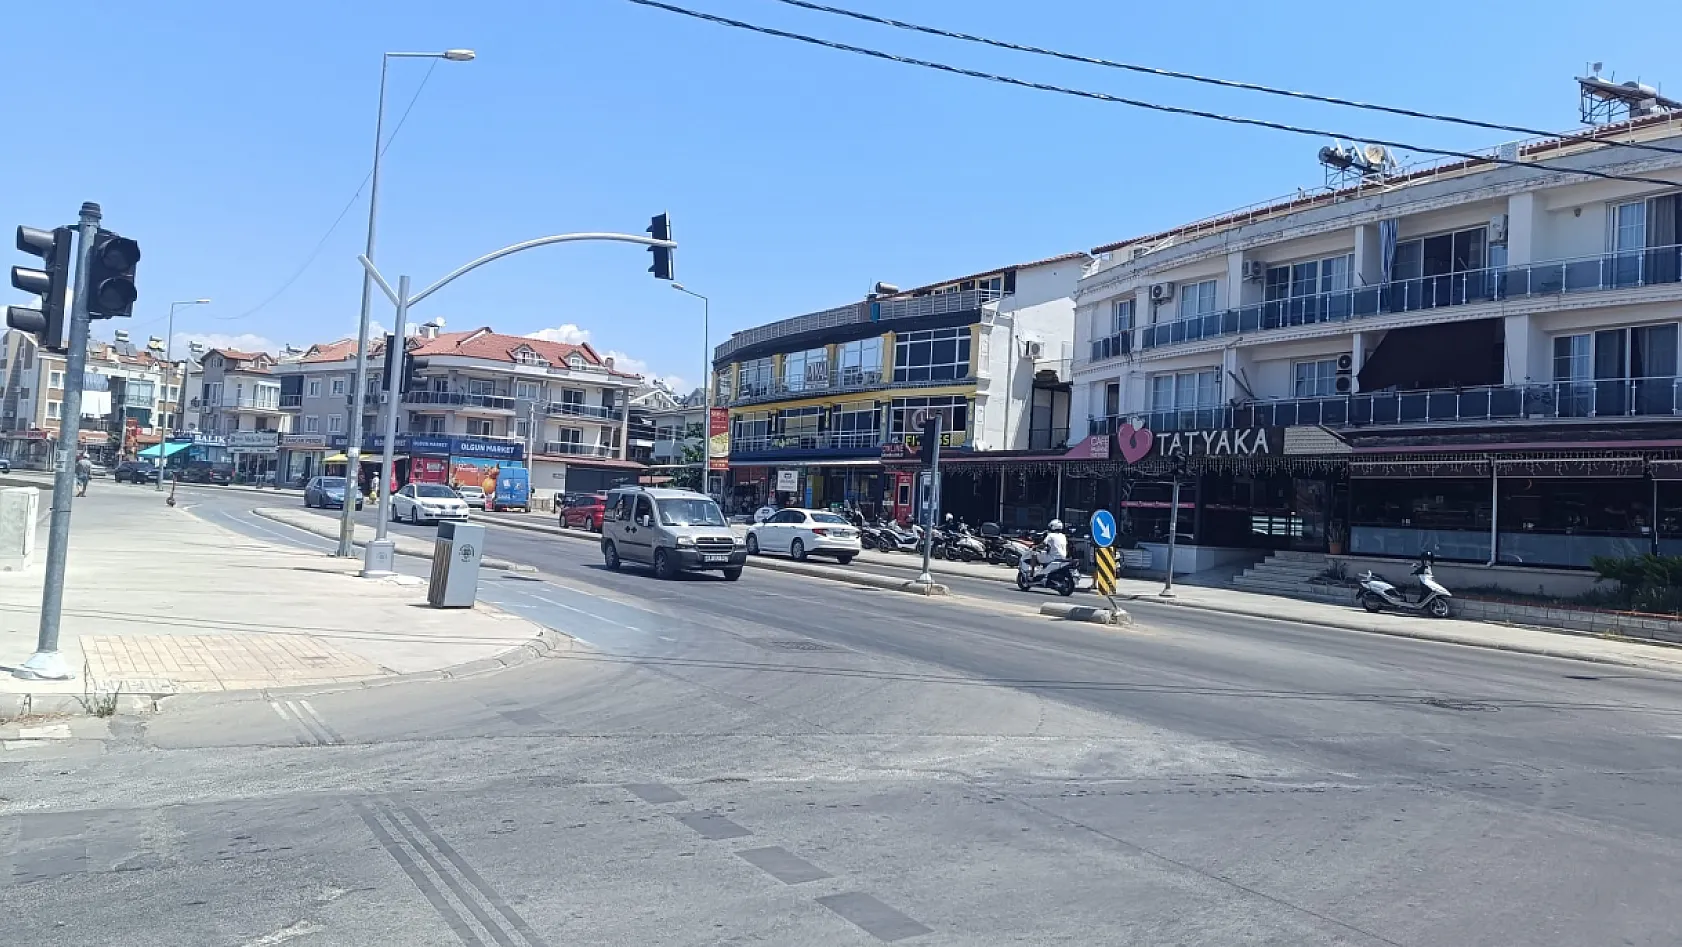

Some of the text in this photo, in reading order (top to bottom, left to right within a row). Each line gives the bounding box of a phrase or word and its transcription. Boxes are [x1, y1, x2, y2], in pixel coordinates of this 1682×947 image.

[461, 442, 515, 454] OLGUN MARKET
[1156, 428, 1269, 457] TATYAKA
